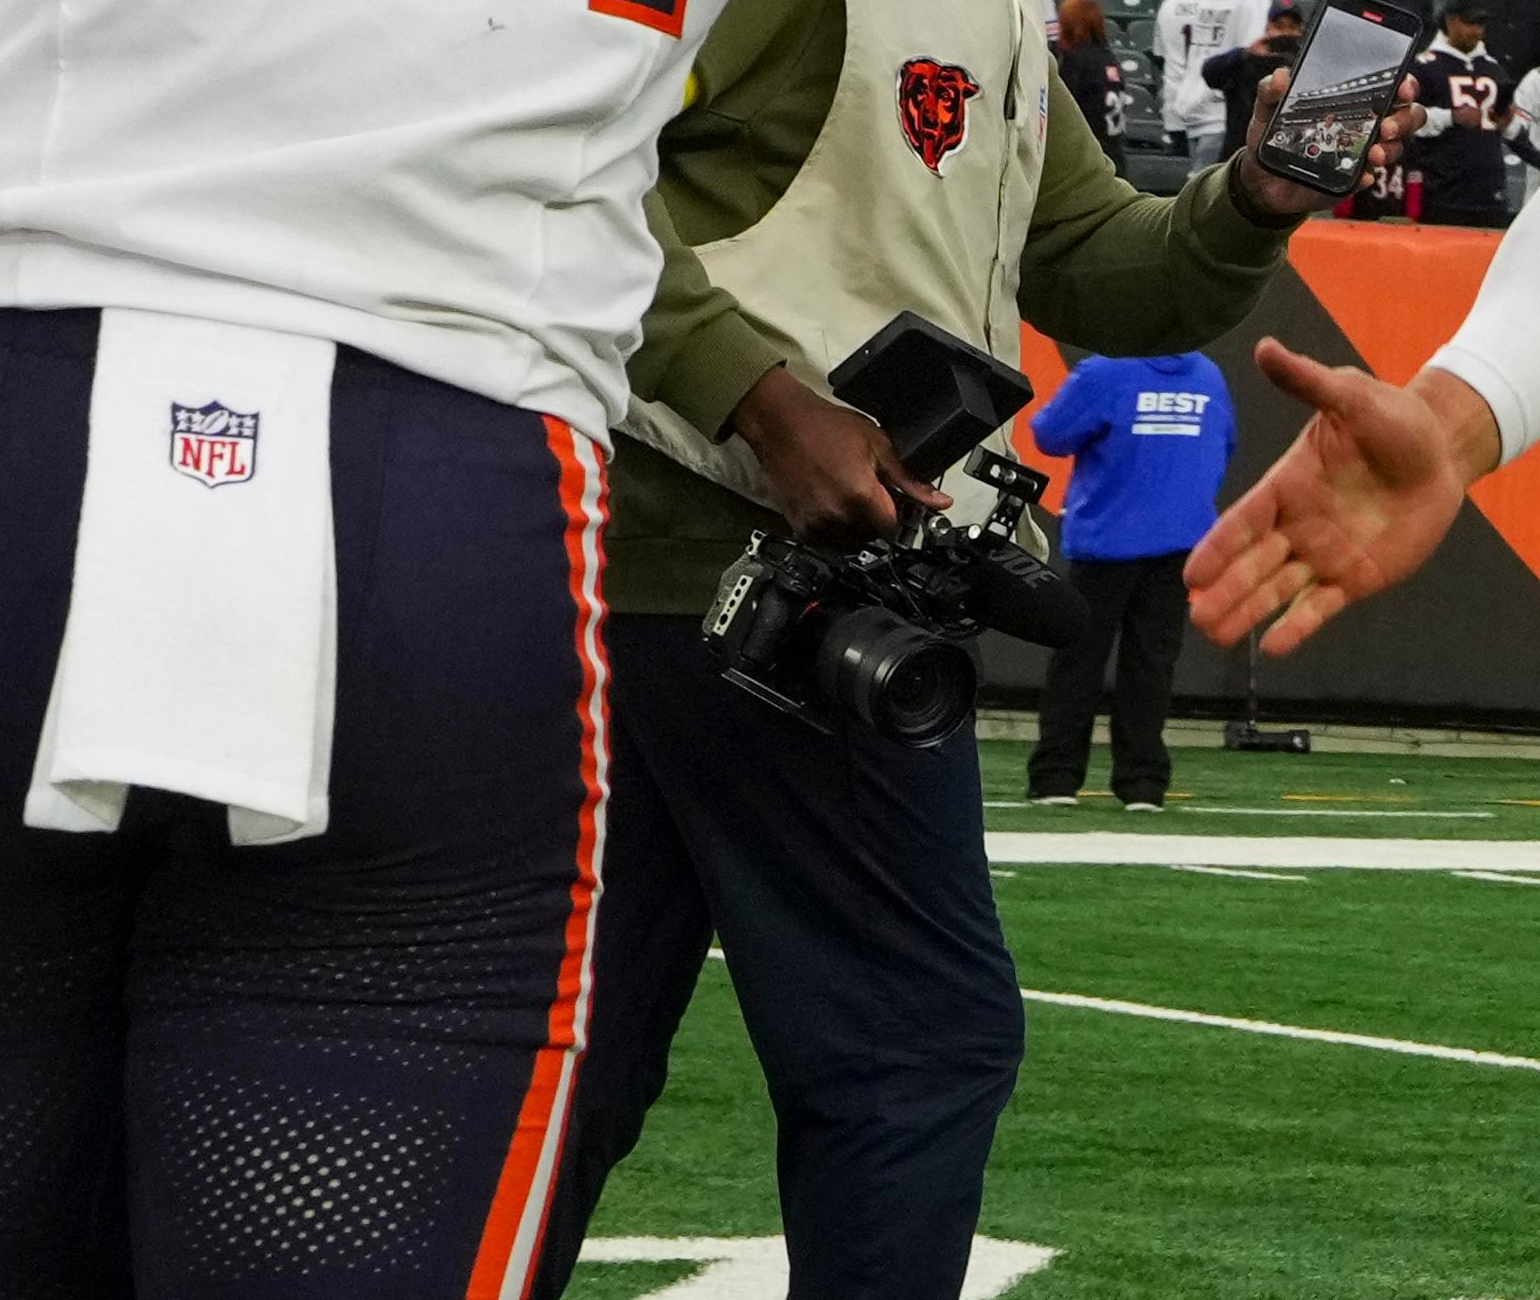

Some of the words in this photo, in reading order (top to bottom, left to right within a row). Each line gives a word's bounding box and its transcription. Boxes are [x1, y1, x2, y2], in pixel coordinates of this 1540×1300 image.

[1373, 164, 1404, 200] 34
[1136, 392, 1210, 414] BEST
[179, 436, 247, 478] NFL
